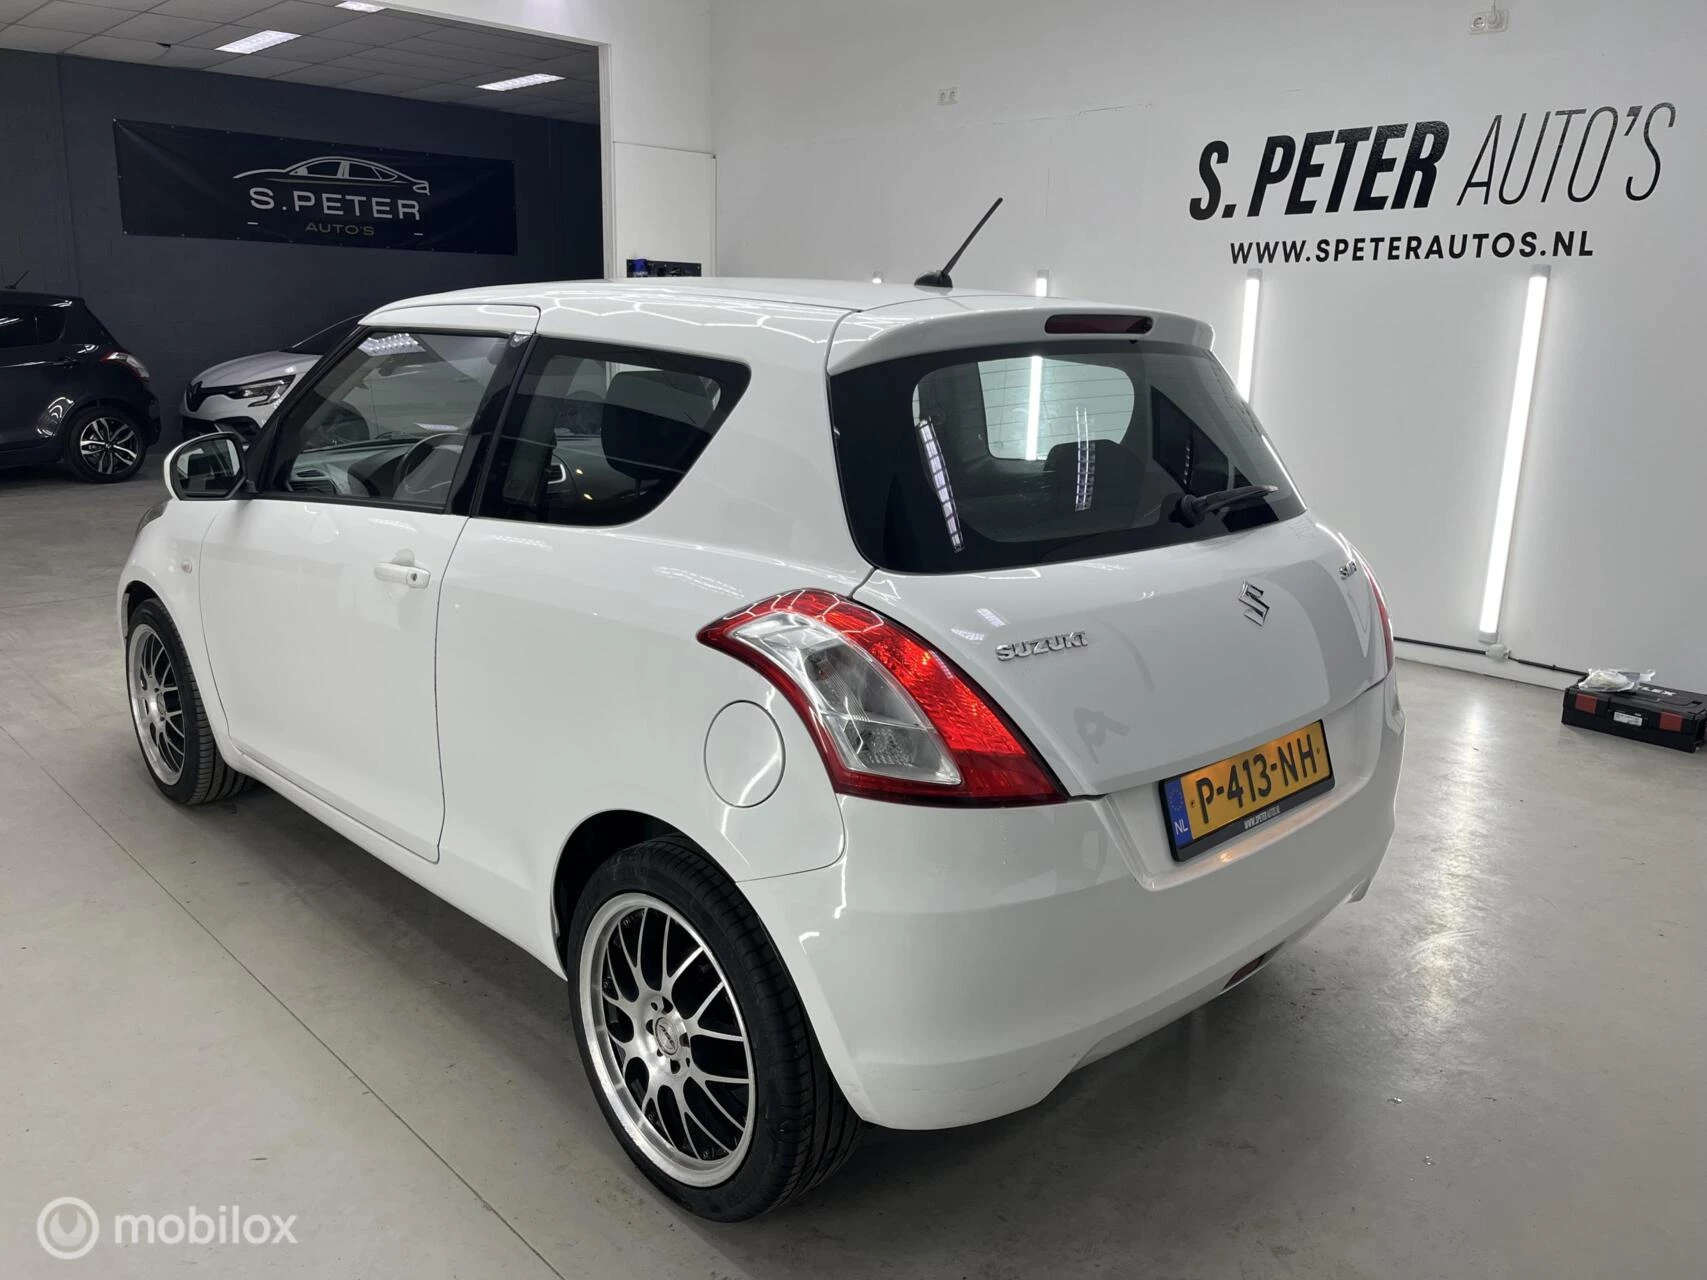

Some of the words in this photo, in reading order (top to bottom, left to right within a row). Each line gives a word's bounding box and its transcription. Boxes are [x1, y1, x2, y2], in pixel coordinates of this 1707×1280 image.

[1456, 102, 1676, 206] AUTO'S
[305, 222, 375, 236] AUTO'S
[1230, 231, 1594, 264] WWW.SPETERAUTOS.NL
[995, 631, 1088, 661] SUZUKI
[1195, 733, 1317, 824] P-413-NH
[1174, 818, 1189, 836] NL
